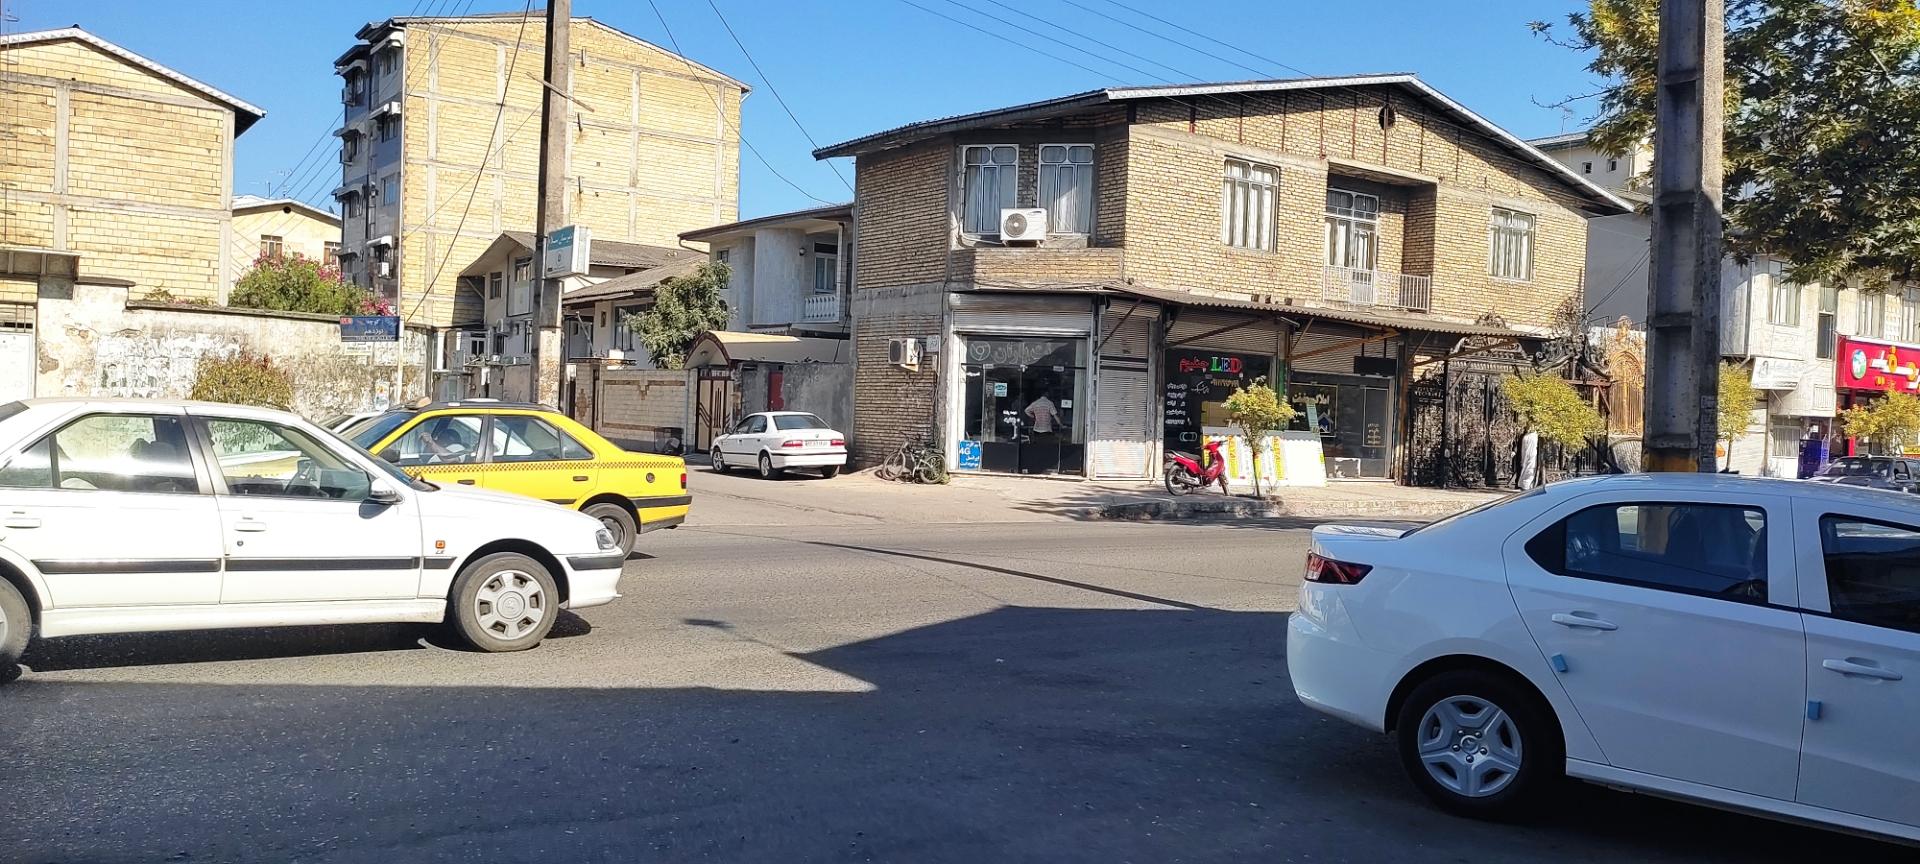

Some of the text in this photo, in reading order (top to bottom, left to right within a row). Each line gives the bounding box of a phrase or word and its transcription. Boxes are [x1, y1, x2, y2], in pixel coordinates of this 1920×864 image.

[364, 328, 385, 336] نوزدهم
[1210, 356, 1242, 373] LED
[959, 447, 971, 455] 4G
